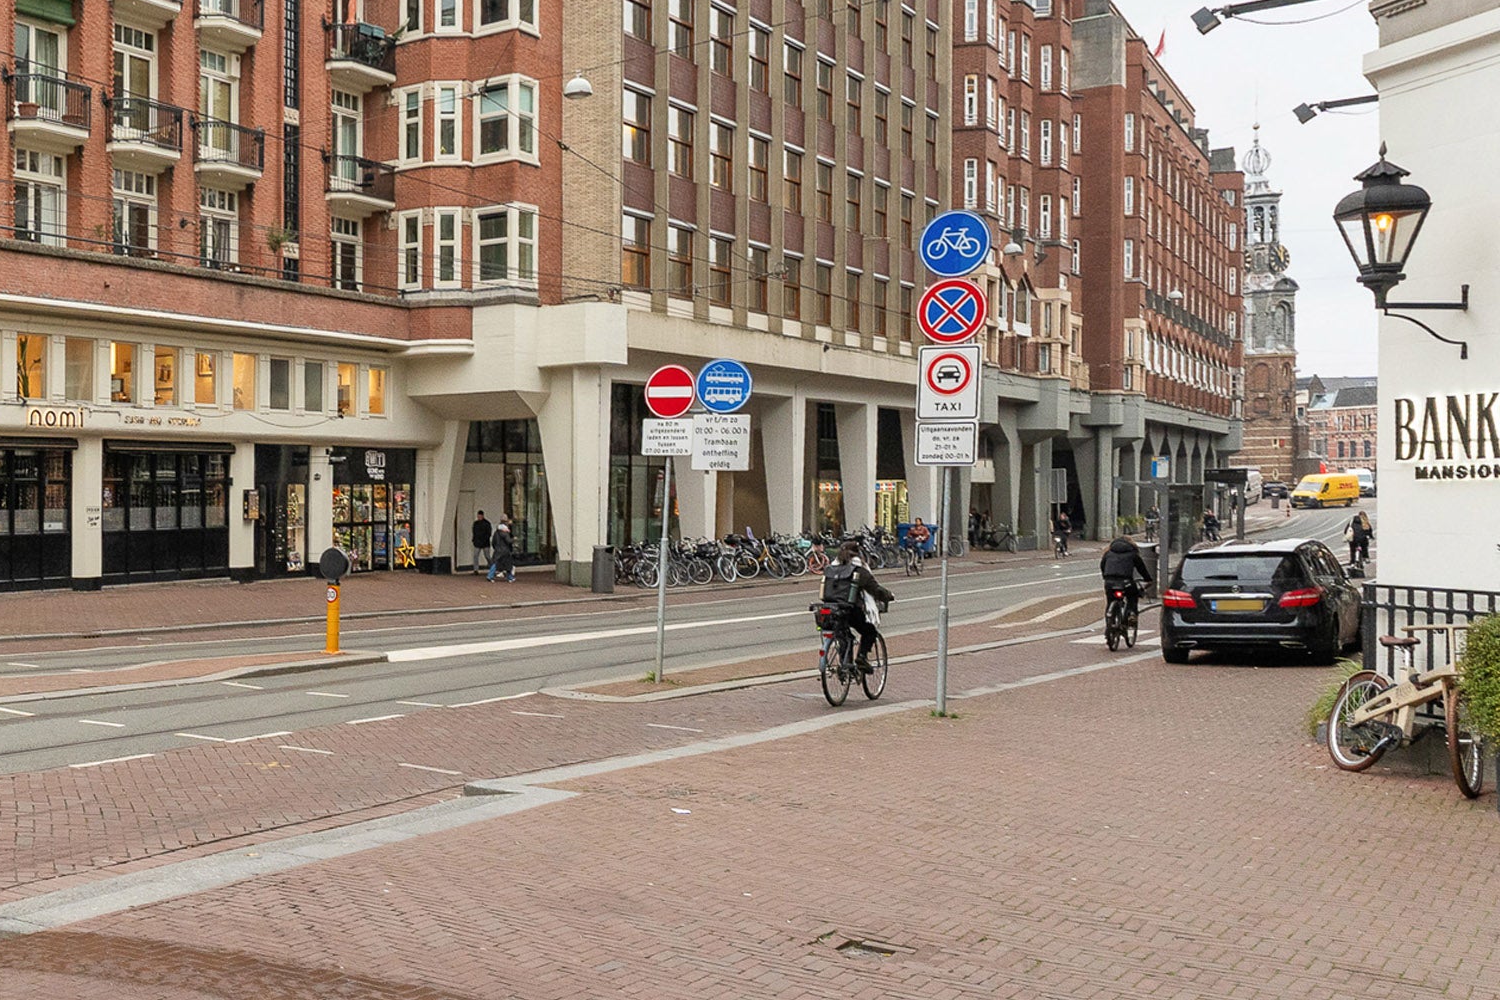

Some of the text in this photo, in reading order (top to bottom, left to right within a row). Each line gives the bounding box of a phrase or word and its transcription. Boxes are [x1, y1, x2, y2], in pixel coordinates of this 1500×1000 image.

[934, 402, 962, 411] TAXI
[29, 407, 84, 428] nomi
[743, 427, 748, 435] h
[1394, 392, 1500, 461] BANK
[703, 438, 738, 446] Trambaan
[702, 449, 739, 458] ontheffing
[709, 461, 731, 469] geldig
